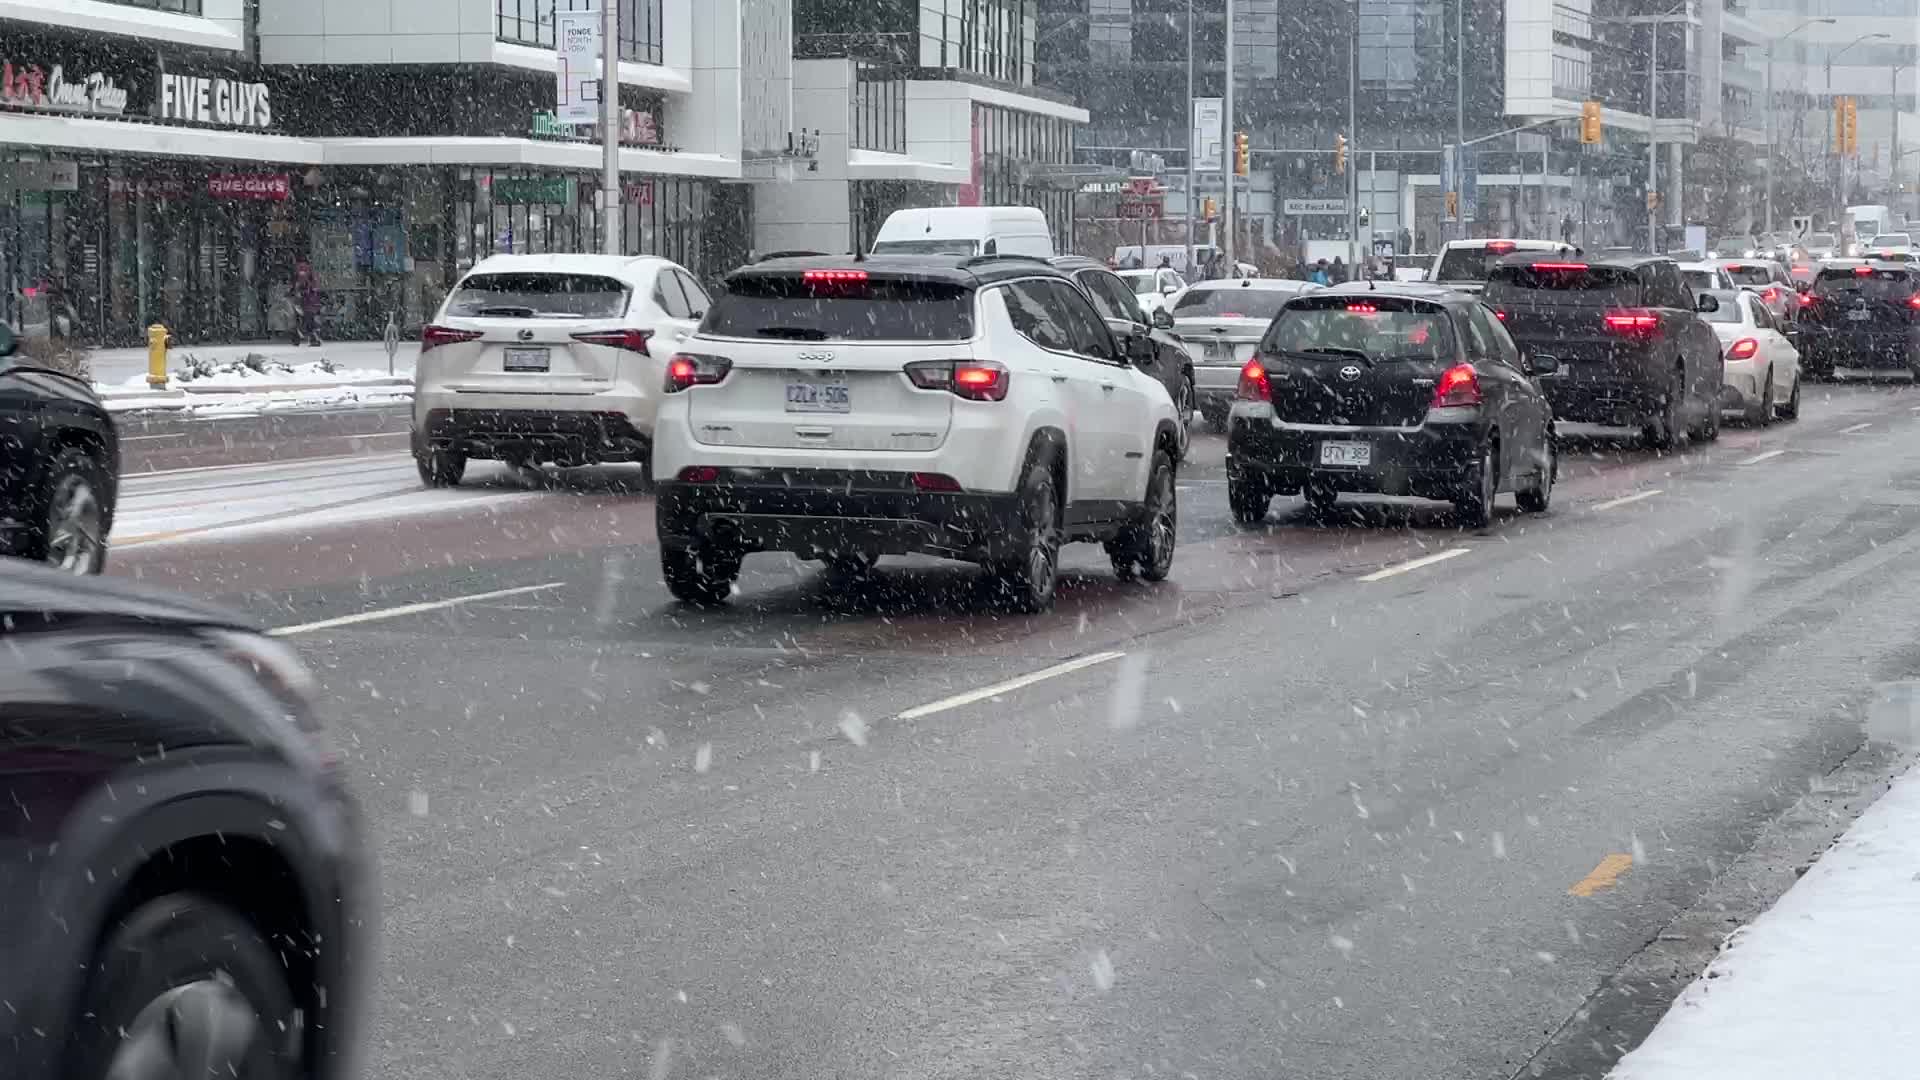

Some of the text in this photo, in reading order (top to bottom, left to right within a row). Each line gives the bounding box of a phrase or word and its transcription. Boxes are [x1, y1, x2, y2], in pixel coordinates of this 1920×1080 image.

[567, 28, 592, 36] YONGE
[567, 37, 592, 45] NORTH
[567, 45, 587, 53] YORK
[161, 73, 271, 127] FIVE GUYS
[209, 179, 286, 193] FIVE GUYS
